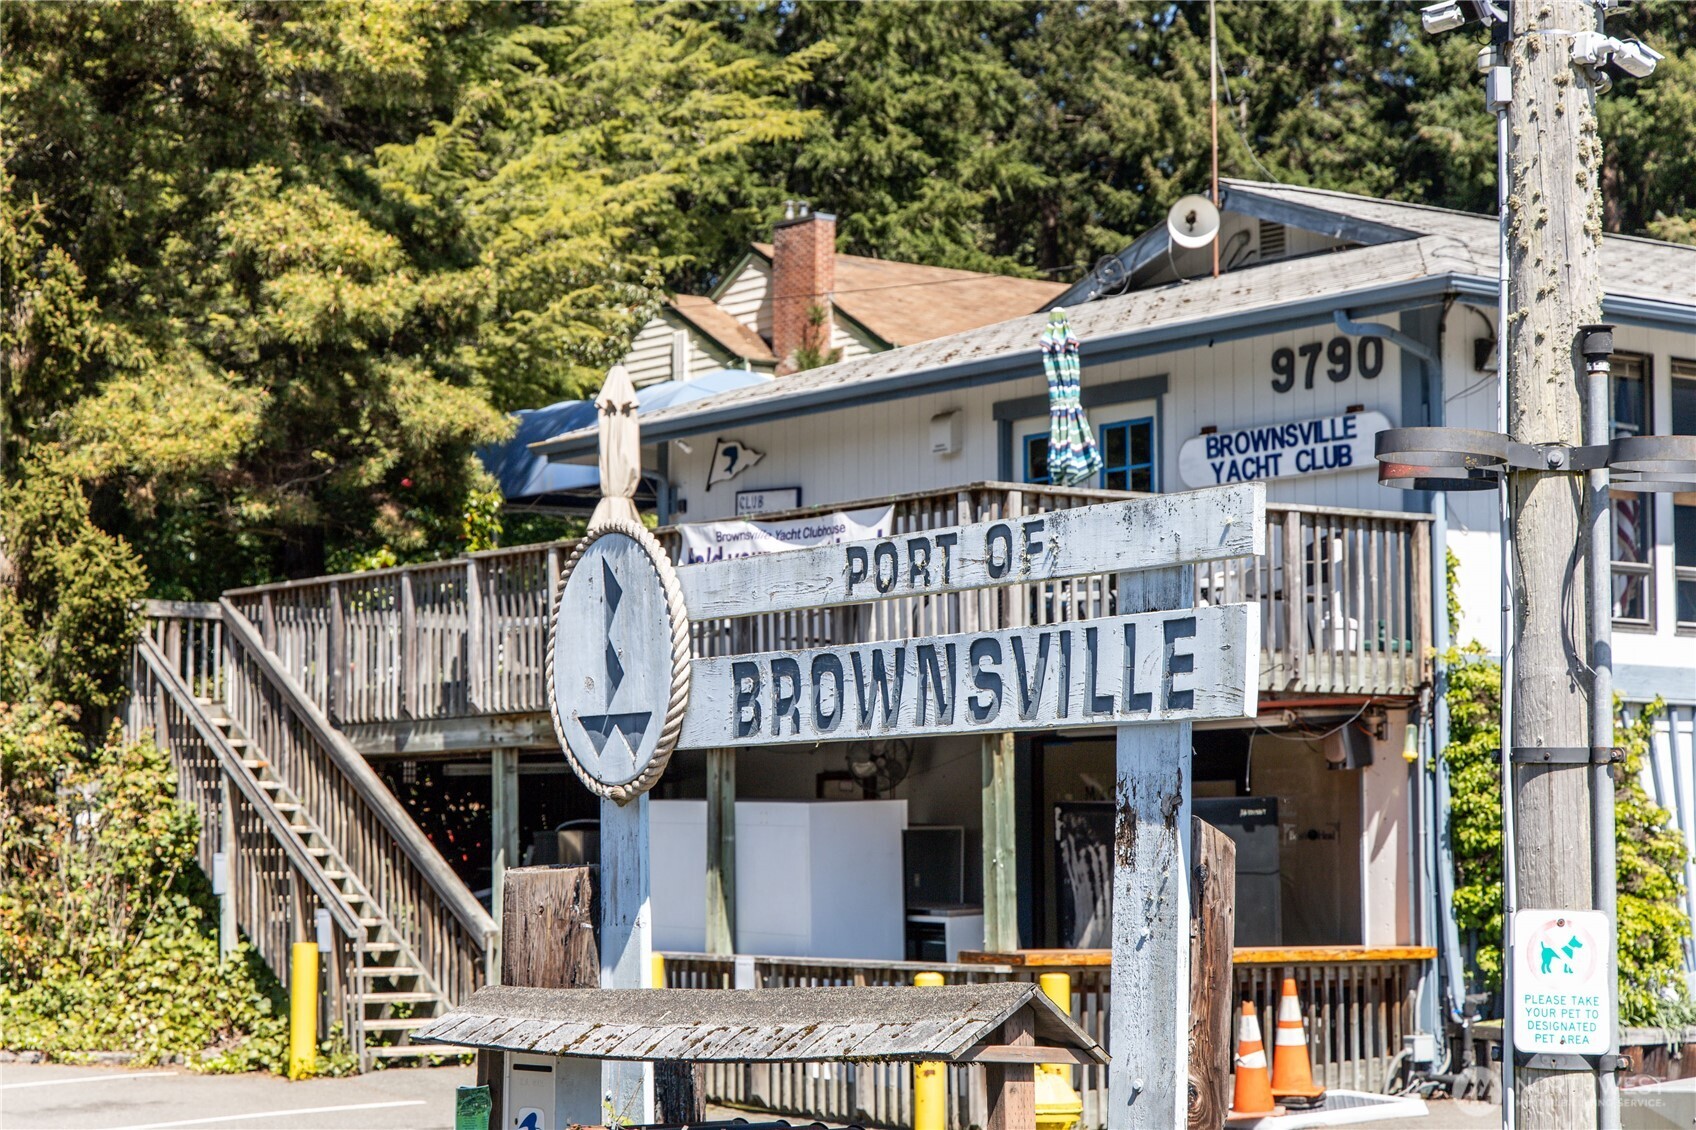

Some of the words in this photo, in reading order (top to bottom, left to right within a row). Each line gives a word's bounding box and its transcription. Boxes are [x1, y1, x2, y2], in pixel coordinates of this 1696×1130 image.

[1271, 336, 1384, 394] 9790
[1206, 415, 1358, 459] BROWNSVILLE
[1211, 453, 1283, 484] YACHT
[1295, 444, 1353, 473] CLUB
[739, 495, 764, 510] CLUB
[716, 529, 772, 543] Brownsville
[775, 528, 802, 541] Yacht
[802, 524, 846, 539] Clubhouse
[844, 533, 957, 596] PORT
[986, 520, 1045, 579] OF
[732, 617, 1196, 738] BROWNSVILLE
[1524, 994, 1566, 1005] PLEASE
[1572, 996, 1600, 1006] TAKE
[1525, 1008, 1556, 1018] YOUR
[1561, 1009, 1581, 1019] PET
[1586, 1009, 1599, 1019] TO
[1527, 1021, 1597, 1032] DESIGNATED
[1534, 1034, 1555, 1043] PET
[1560, 1035, 1590, 1044] AREA
